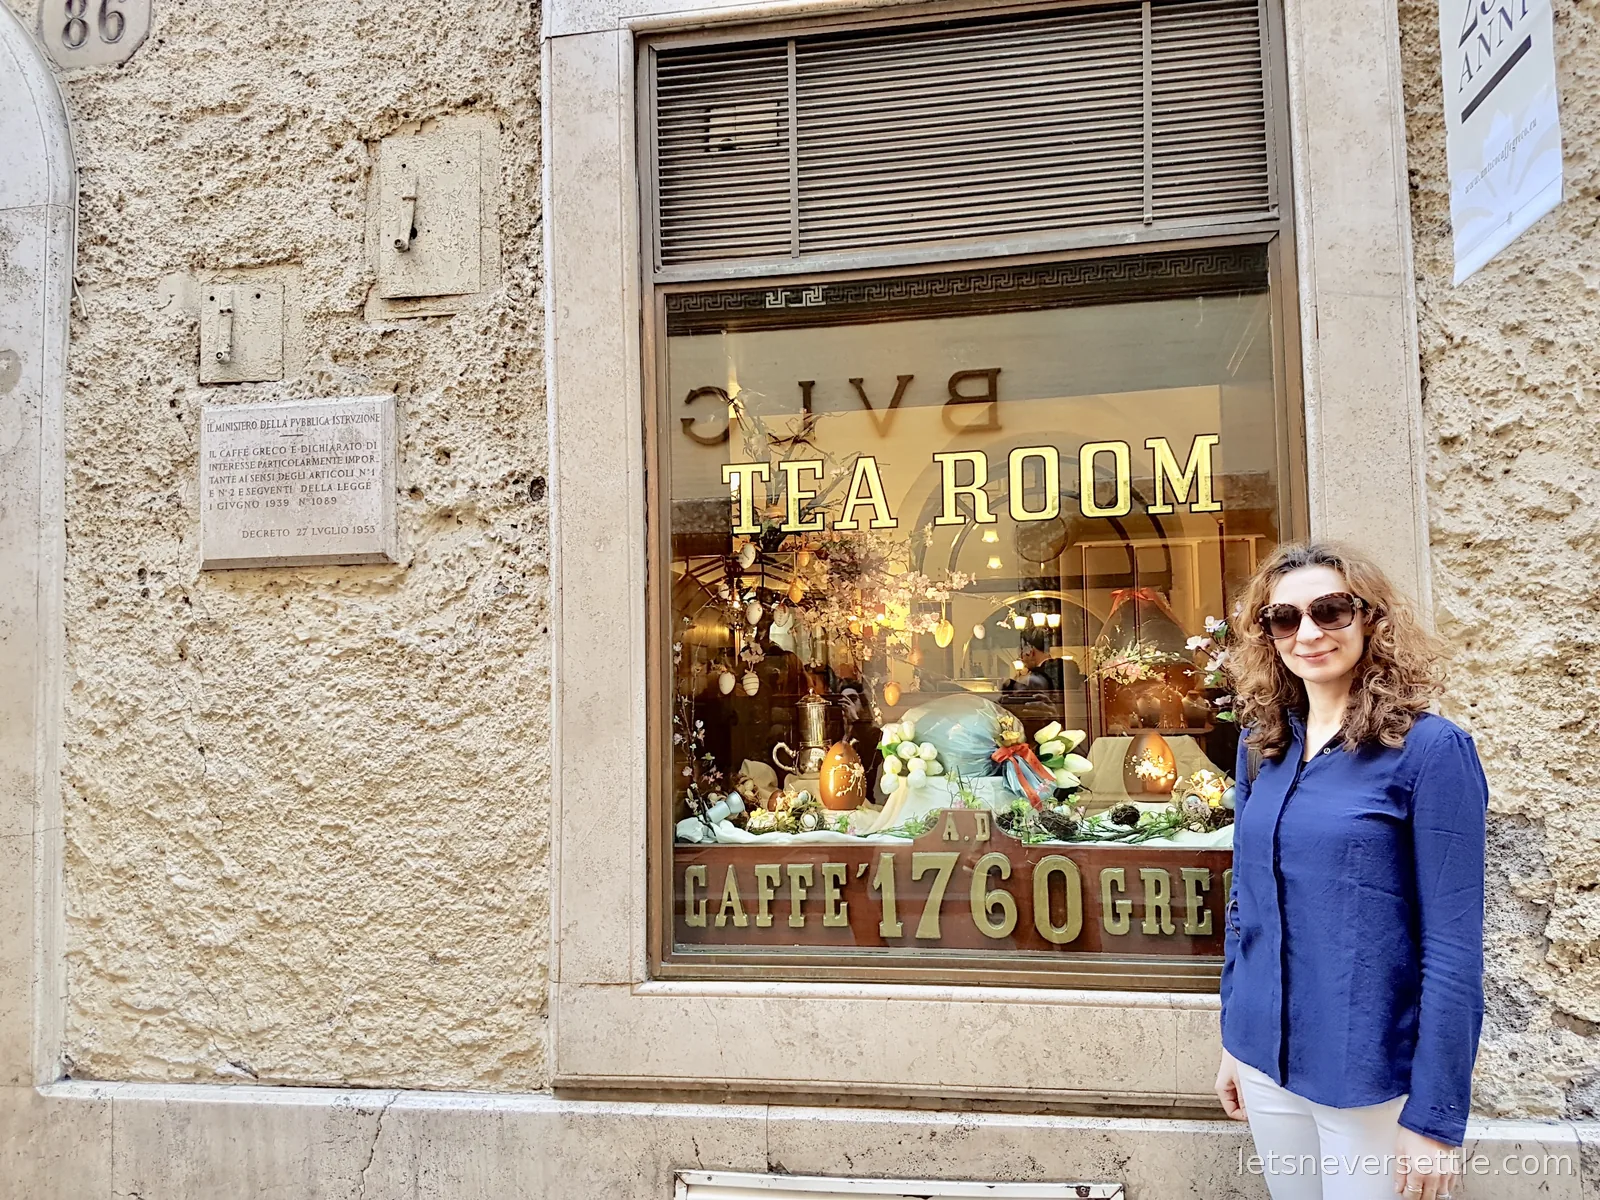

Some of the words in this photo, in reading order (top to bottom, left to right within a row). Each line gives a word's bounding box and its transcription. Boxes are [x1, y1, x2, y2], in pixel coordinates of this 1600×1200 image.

[62, 0, 125, 50] 86
[206, 423, 214, 432] IL
[215, 421, 257, 433] MINISTERO
[260, 418, 288, 429] DELLA
[290, 416, 329, 427] PVBBLICA
[332, 413, 380, 425] ISTRVZIONE
[252, 446, 286, 456] GRECO
[301, 442, 362, 453] DICHIARATO
[366, 441, 377, 450] DI
[209, 461, 256, 472] INTERESSE
[257, 455, 343, 469] PARTICOLARMENTE
[209, 475, 236, 485] TANTE
[238, 474, 248, 483] AI
[250, 472, 275, 483] SENSI
[278, 471, 306, 481] DEGLI
[309, 469, 354, 479] ARTICOLI
[721, 455, 898, 534] TEA
[932, 433, 1224, 525] ROOM
[209, 489, 214, 498] E
[238, 488, 244, 496] E
[246, 485, 293, 496] SEGVENTI
[301, 484, 333, 493] DELLA
[217, 500, 260, 511] GIVGNO
[265, 498, 290, 508] 1939
[242, 528, 290, 539] DECRETO
[296, 526, 308, 537] 27
[311, 525, 349, 536] LVGLIO
[352, 525, 376, 535] 1953
[872, 850, 1084, 945] 1760
[1100, 867, 1233, 935] GRE
